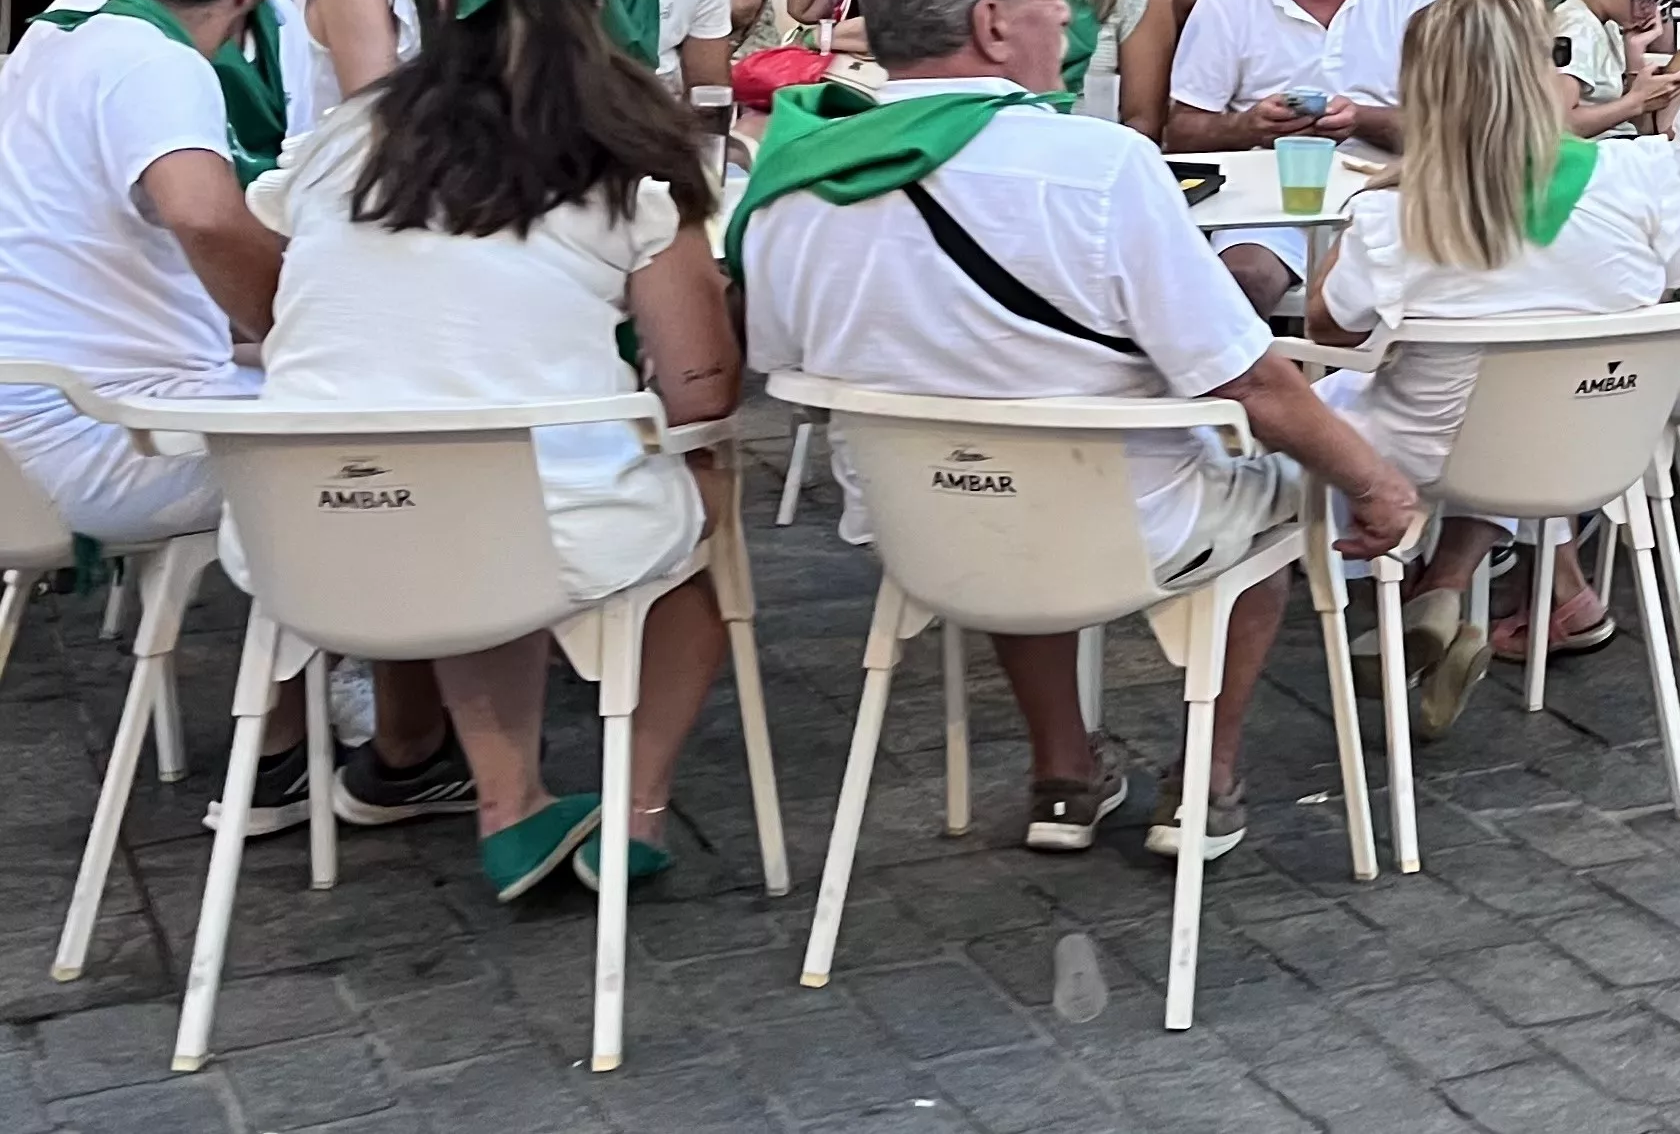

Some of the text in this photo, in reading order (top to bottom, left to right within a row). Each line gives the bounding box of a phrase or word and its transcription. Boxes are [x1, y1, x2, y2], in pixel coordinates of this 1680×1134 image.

[1574, 373, 1638, 395] AMBAR
[931, 470, 1018, 494] AMBAR
[318, 489, 417, 509] AMBAR
